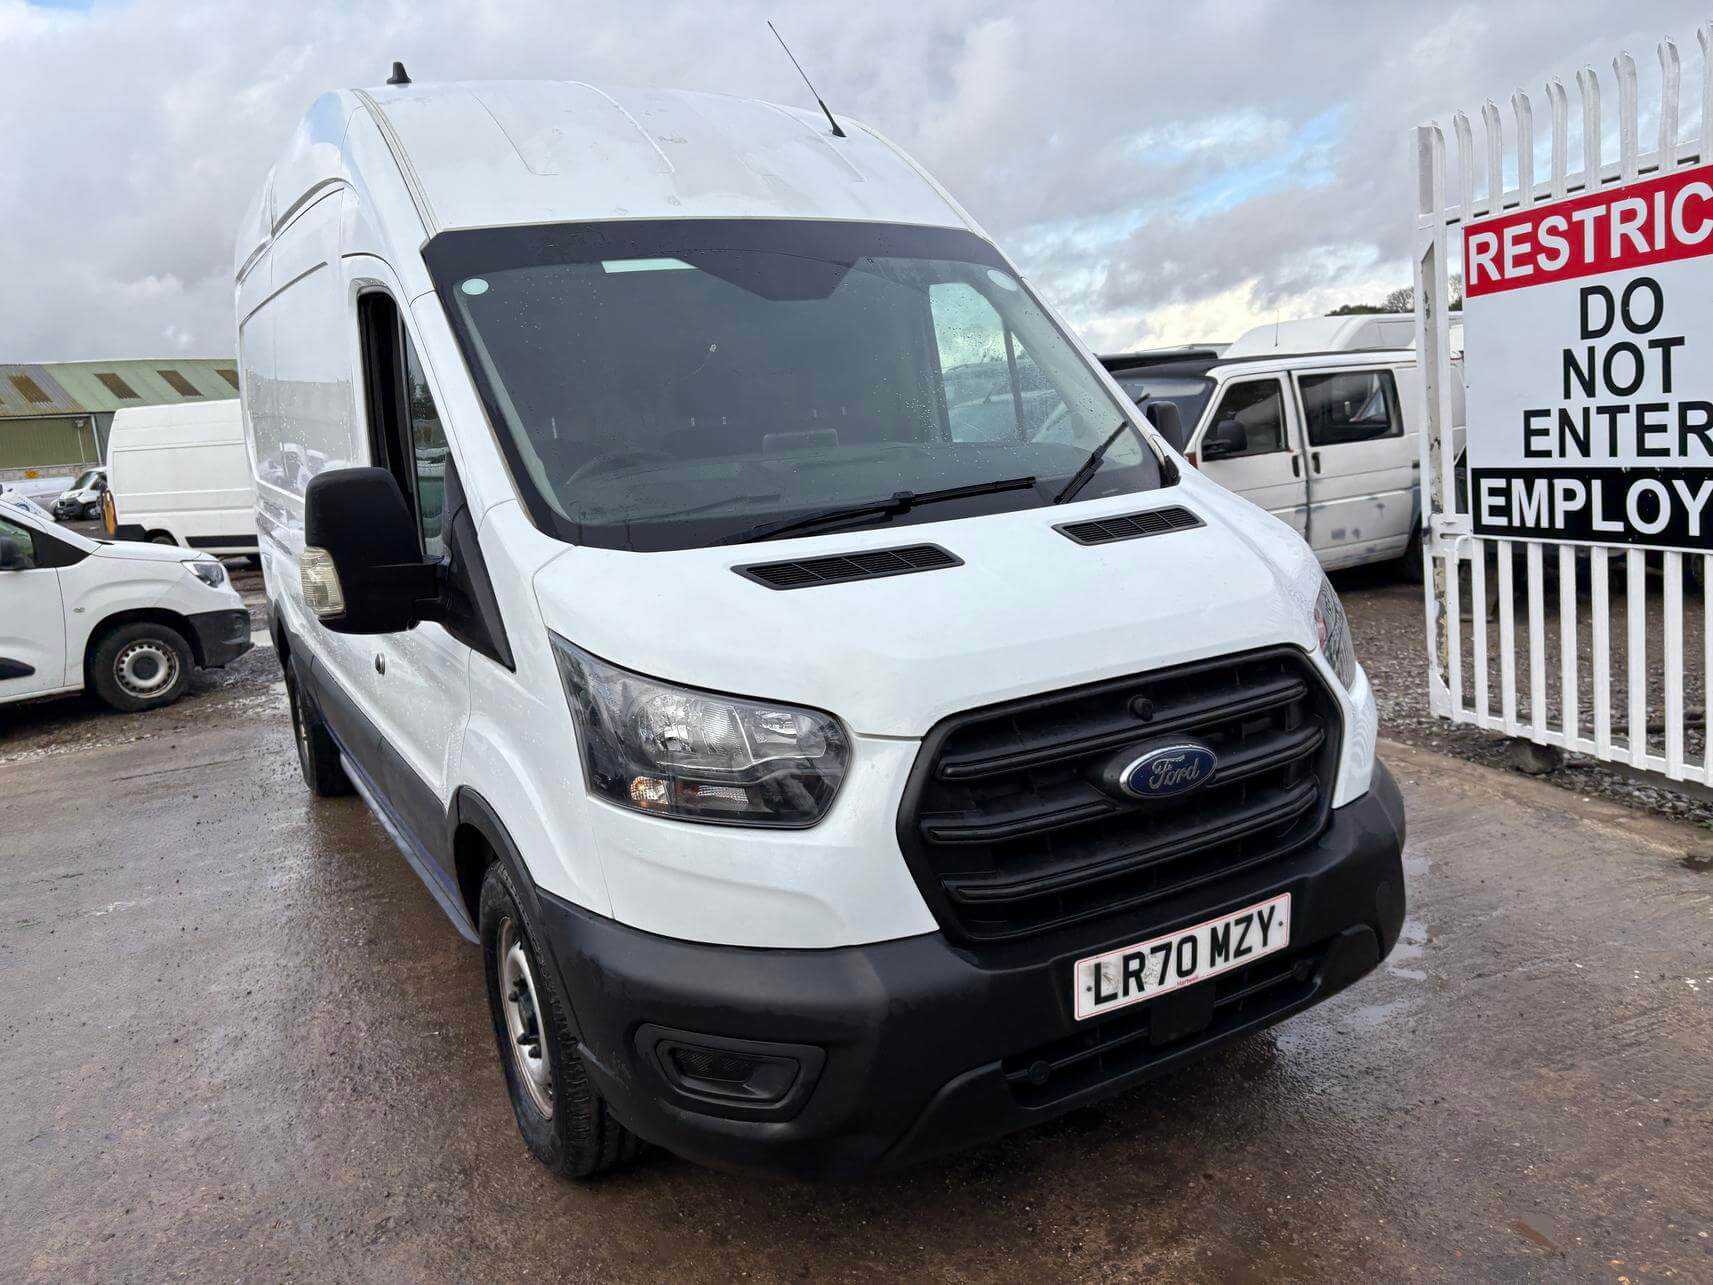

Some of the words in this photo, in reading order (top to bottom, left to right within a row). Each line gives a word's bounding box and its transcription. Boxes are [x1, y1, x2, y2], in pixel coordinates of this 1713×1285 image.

[1468, 181, 1713, 285] RESTRIC
[1580, 276, 1664, 340] DO
[1563, 335, 1685, 400] NOT
[1523, 400, 1713, 459] ENTER
[1480, 478, 1713, 537] EMPLOY
[1148, 754, 1200, 790] Ford
[1094, 934, 1198, 1006] LR70
[1210, 904, 1276, 968] MZY
